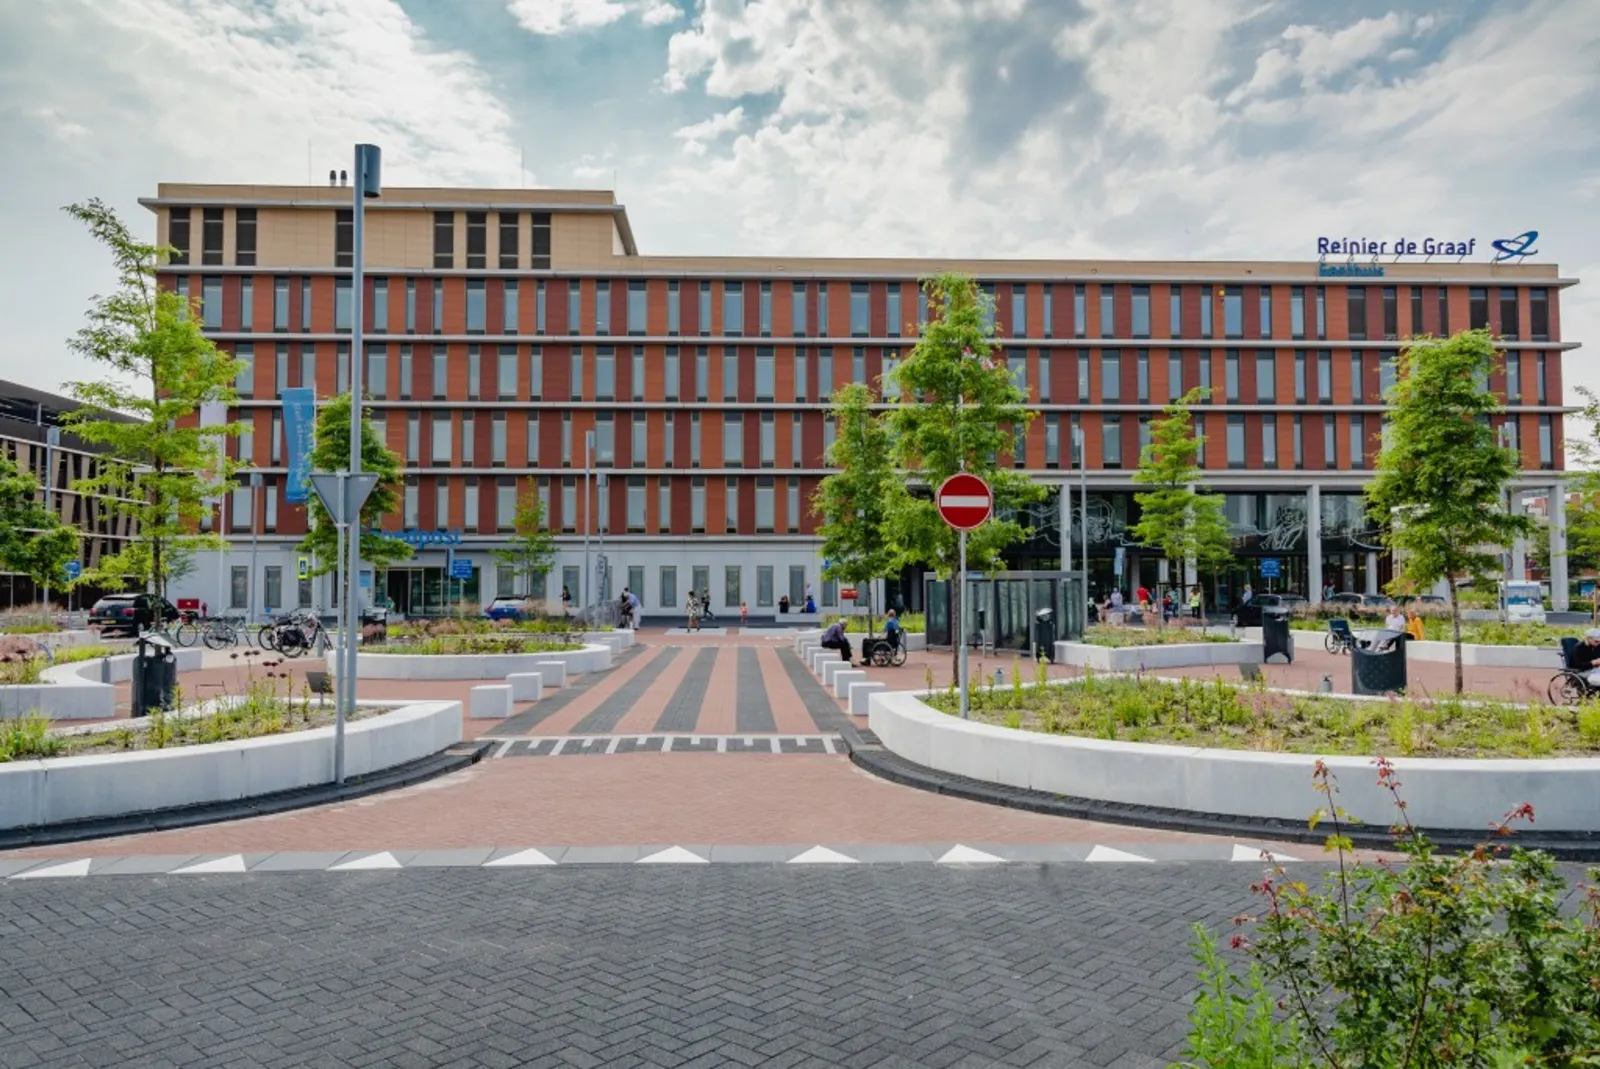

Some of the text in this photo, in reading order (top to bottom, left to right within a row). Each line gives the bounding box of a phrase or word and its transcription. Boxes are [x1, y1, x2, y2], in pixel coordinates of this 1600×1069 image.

[1318, 237, 1476, 255] Reinier de Graaf
